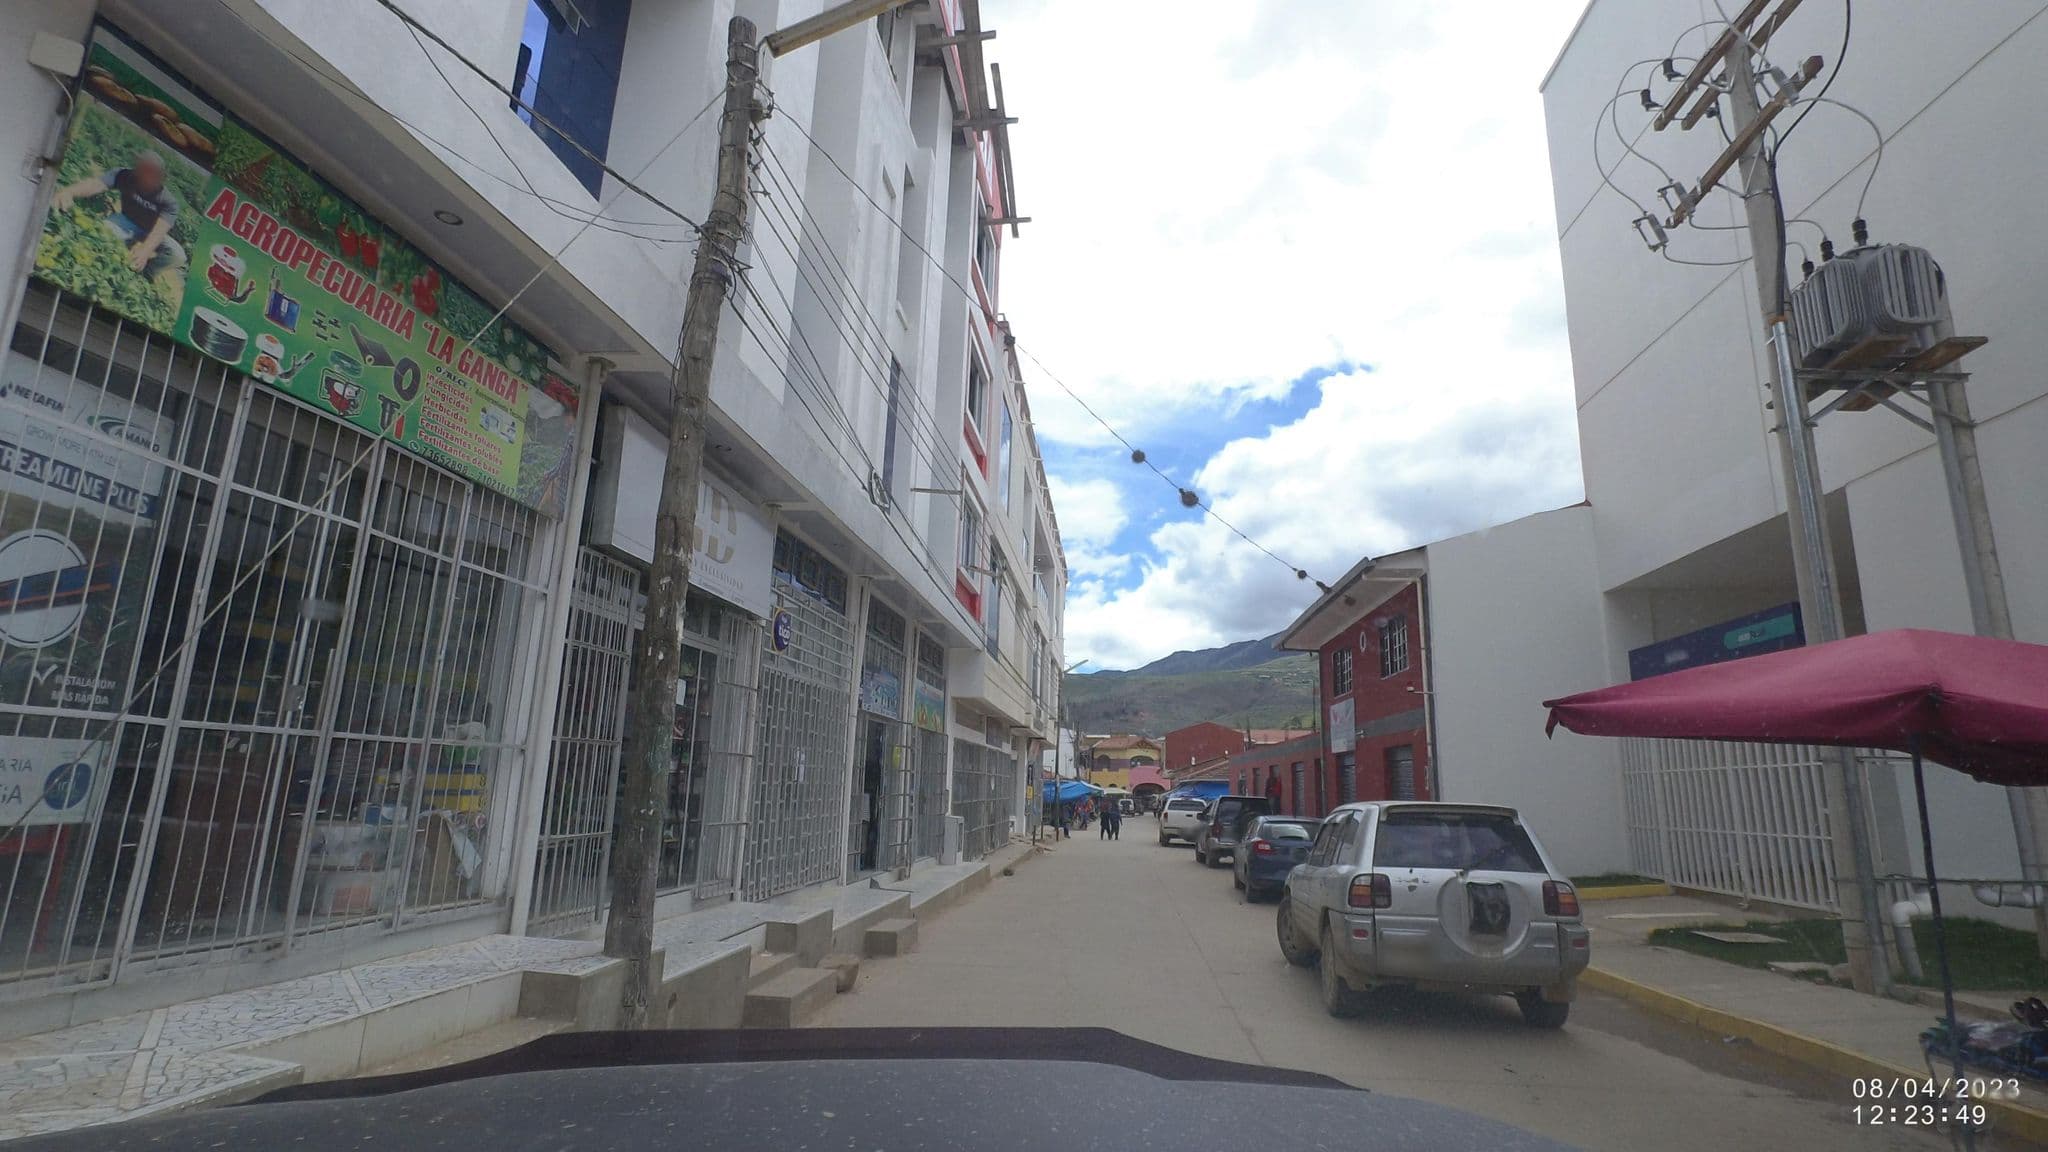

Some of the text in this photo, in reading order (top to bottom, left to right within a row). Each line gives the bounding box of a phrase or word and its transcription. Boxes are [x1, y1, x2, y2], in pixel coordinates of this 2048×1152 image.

[207, 188, 416, 341] AGROPECUARIA
[426, 382, 469, 413] Fungicidas
[427, 371, 472, 405] Insecticidas
[421, 405, 473, 437] Fertilizantes
[424, 394, 468, 424] Herbicidas
[419, 429, 470, 461] Fertilizantes
[420, 417, 471, 449] Fertilizantes
[109, 484, 149, 514] PLUS
